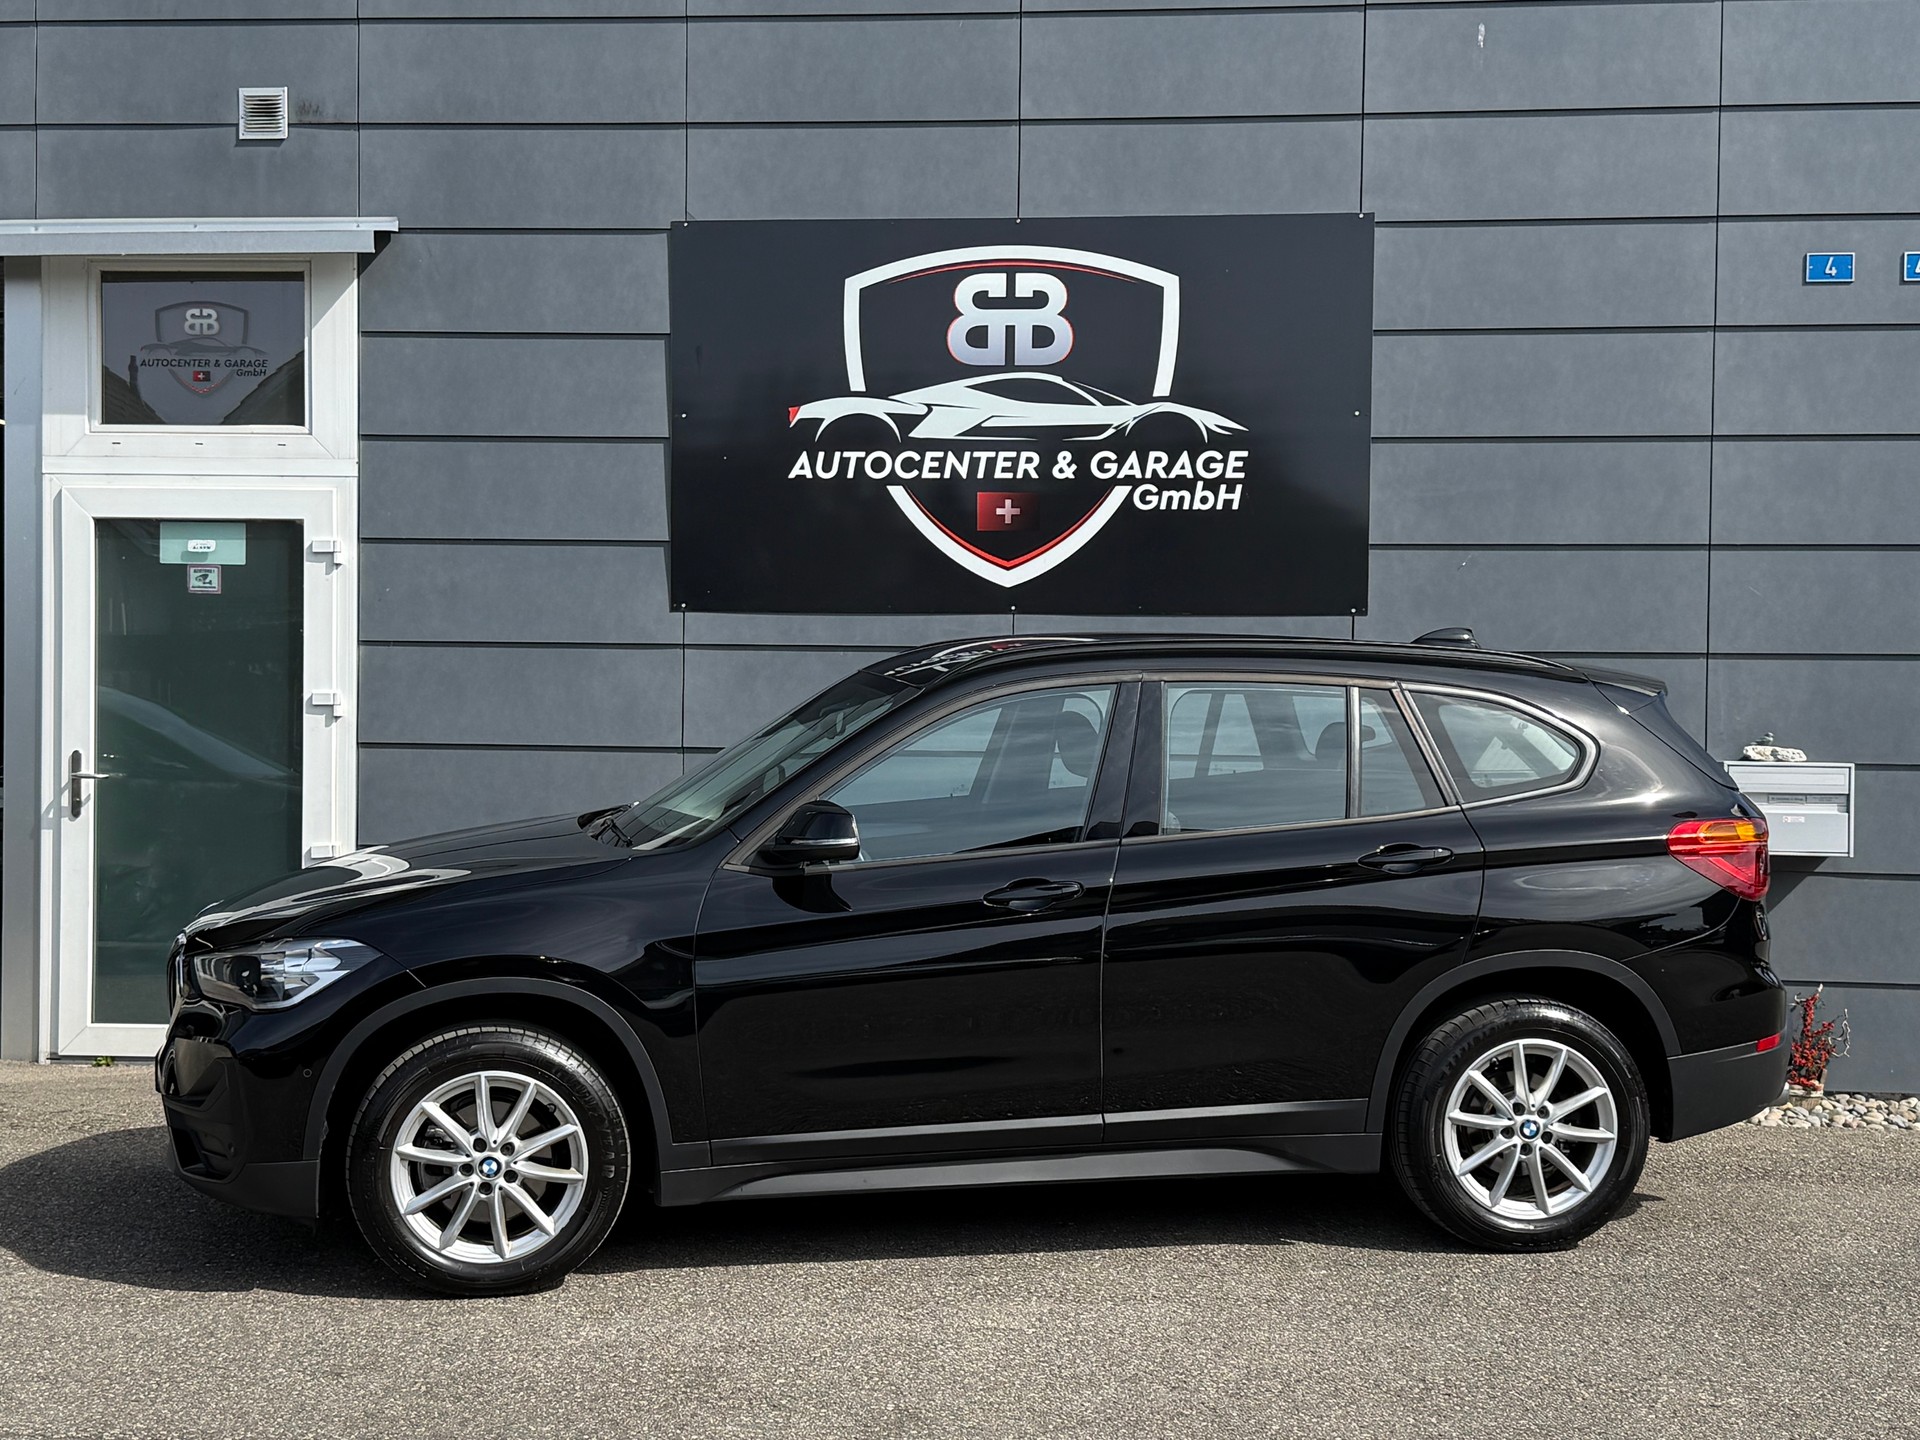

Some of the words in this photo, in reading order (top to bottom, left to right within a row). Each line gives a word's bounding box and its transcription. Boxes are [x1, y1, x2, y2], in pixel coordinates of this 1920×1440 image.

[1825, 256, 1838, 276] 4
[140, 358, 211, 368] AUTOCENTER
[213, 358, 221, 368] &
[224, 359, 269, 368] GARAGE
[236, 368, 267, 377] GmbH
[788, 450, 1040, 480] AUTOCENTER
[1052, 450, 1078, 480] &
[1090, 450, 1249, 480] GARAGE
[1132, 481, 1243, 511] GmbH
